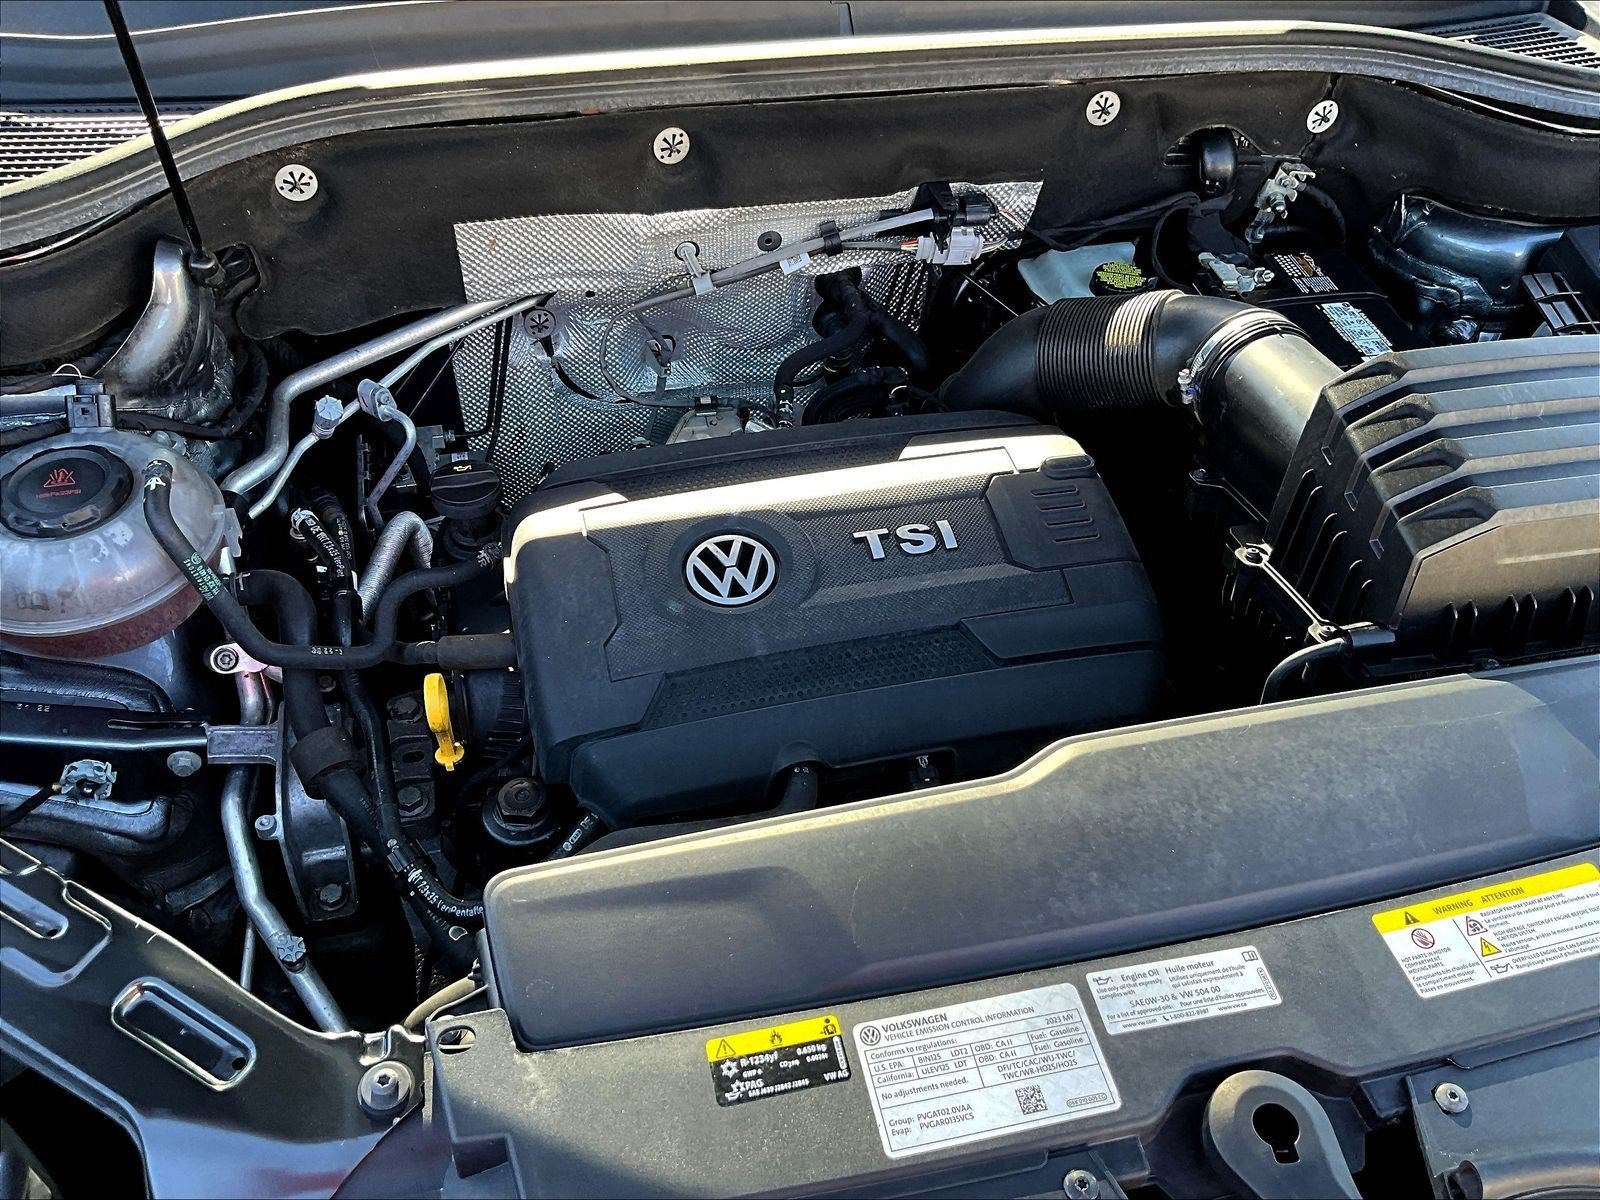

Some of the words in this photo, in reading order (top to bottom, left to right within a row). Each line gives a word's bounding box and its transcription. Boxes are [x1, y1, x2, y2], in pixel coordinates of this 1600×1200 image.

[852, 519, 958, 560] TSI
[1432, 899, 1475, 915] WARNING
[1479, 886, 1526, 904] ATTENTION
[1164, 965, 1186, 974] Huile
[1185, 960, 1216, 971] moteur
[1120, 971, 1148, 983] Engine
[1147, 969, 1161, 979] Oil
[1179, 990, 1195, 999] VW
[1194, 987, 1211, 996] 504
[882, 1013, 948, 1033] VOLKSWAGEN
[884, 1030, 915, 1042] VEHICLE
[915, 1023, 950, 1036] EMISSION
[950, 1016, 985, 1029] CONTROL
[985, 1006, 1035, 1022] INFORMATION
[1045, 1016, 1063, 1025] 2023
[1062, 1013, 1075, 1022] MY
[1030, 1031, 1048, 1041] Fuel:
[1049, 1025, 1080, 1037] Gasoline
[796, 1045, 817, 1057] 0.650
[816, 1042, 828, 1053] kg
[870, 1047, 906, 1062] Conforms
[906, 1045, 915, 1054] to
[914, 1037, 959, 1053] regulations:
[974, 1042, 994, 1052] OBD:
[1034, 1042, 1052, 1052] Fuel:
[1053, 1036, 1084, 1048] Gasoline
[918, 1053, 942, 1064] BIN125
[950, 1047, 969, 1057] LDT2
[954, 1060, 968, 1069] LDT
[978, 1054, 998, 1064] OBD:
[873, 1064, 889, 1073] U.S.
[888, 1060, 906, 1070] EPA:
[921, 1063, 951, 1075] ULEV125
[823, 1071, 838, 1082] VW
[837, 1069, 850, 1079] AG
[877, 1070, 915, 1085] California:
[744, 1078, 765, 1090] PAG
[881, 1091, 894, 1102] No
[893, 1082, 940, 1100] adjustments
[939, 1076, 969, 1090] needed.
[889, 1116, 916, 1129] Group:
[891, 1126, 913, 1138] Evap:
